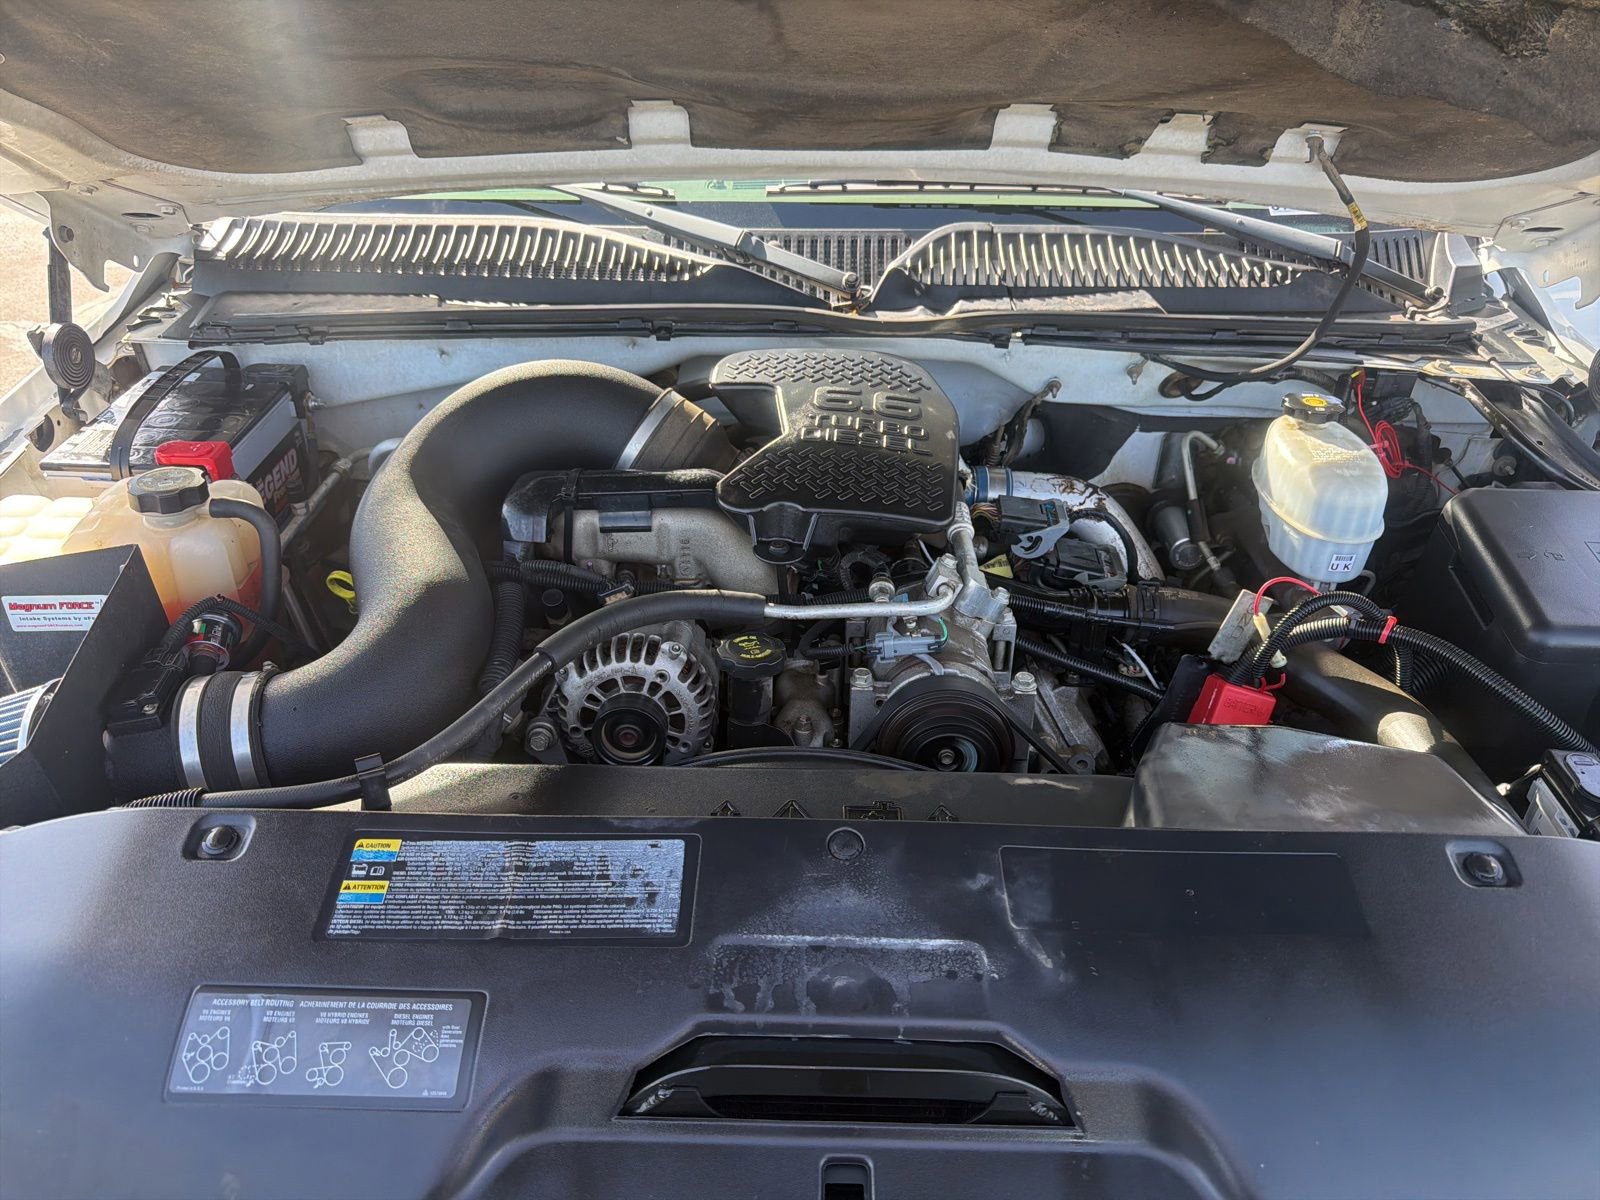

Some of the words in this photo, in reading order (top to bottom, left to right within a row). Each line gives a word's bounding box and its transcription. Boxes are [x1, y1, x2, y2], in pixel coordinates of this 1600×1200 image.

[813, 386, 923, 421] 6.6
[809, 413, 929, 441] TURBO
[800, 426, 933, 457] DIESEL
[8, 602, 57, 612] Magnum
[58, 601, 95, 610] FORCE
[212, 998, 249, 1007] ACCESSORY
[250, 999, 265, 1007] BELT
[265, 999, 295, 1008] ROUTING
[348, 1001, 357, 1009] DE
[411, 1003, 453, 1011] ACCESSOIRES
